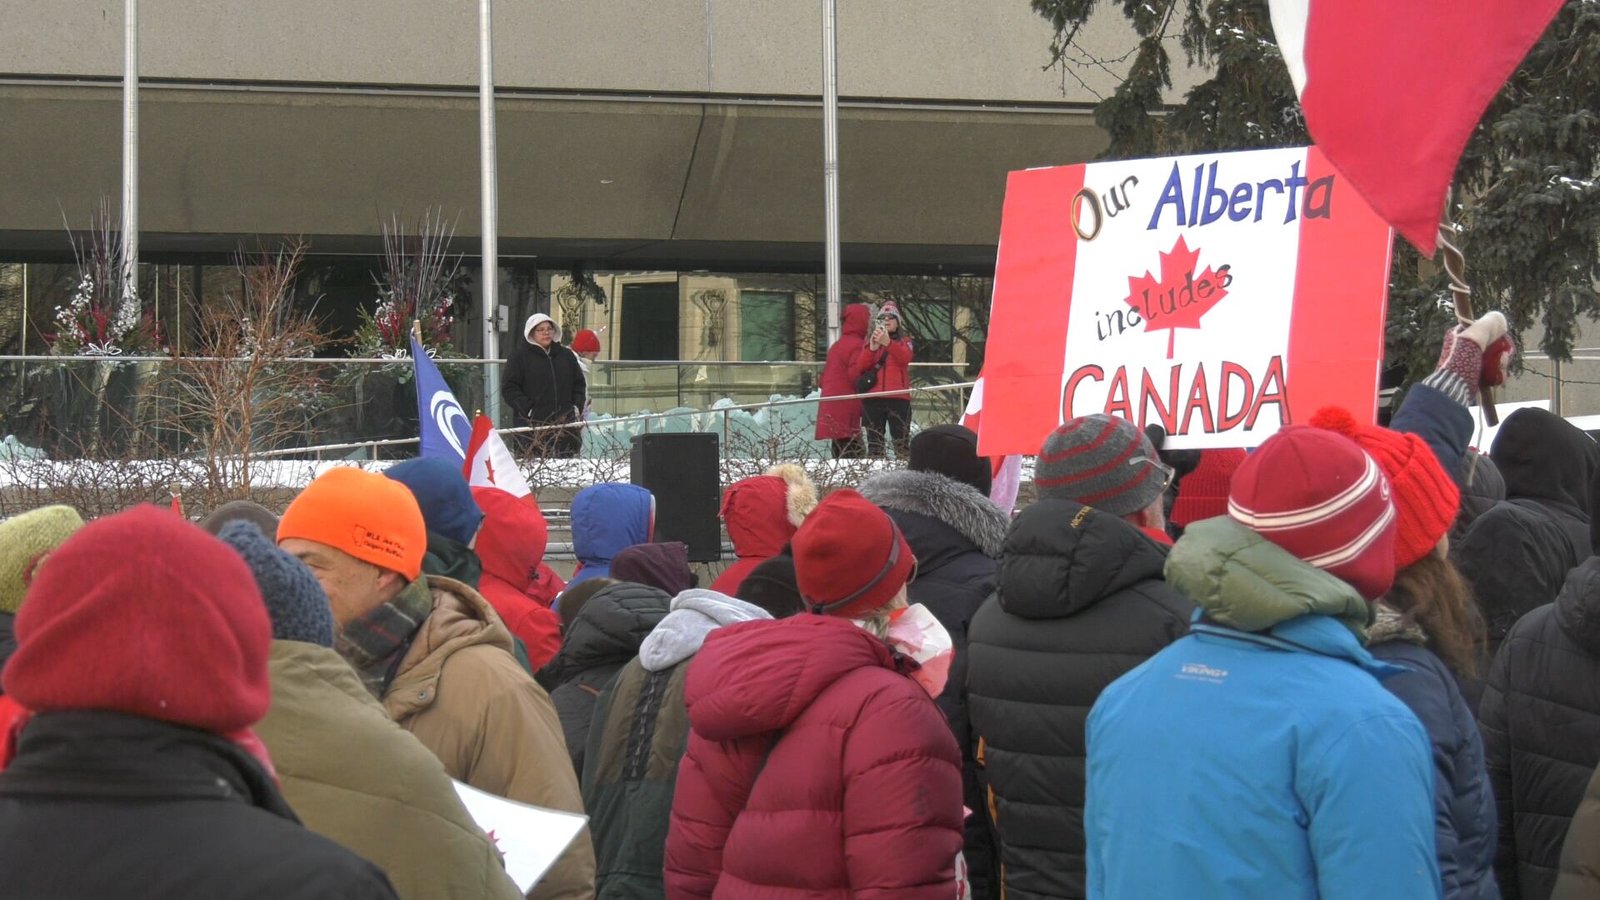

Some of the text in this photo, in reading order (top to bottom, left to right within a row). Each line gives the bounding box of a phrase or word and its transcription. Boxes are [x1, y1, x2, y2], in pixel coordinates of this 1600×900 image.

[1072, 160, 1336, 242] Our Alberta
[1095, 263, 1234, 342] includes
[1062, 355, 1292, 436] CANADA
